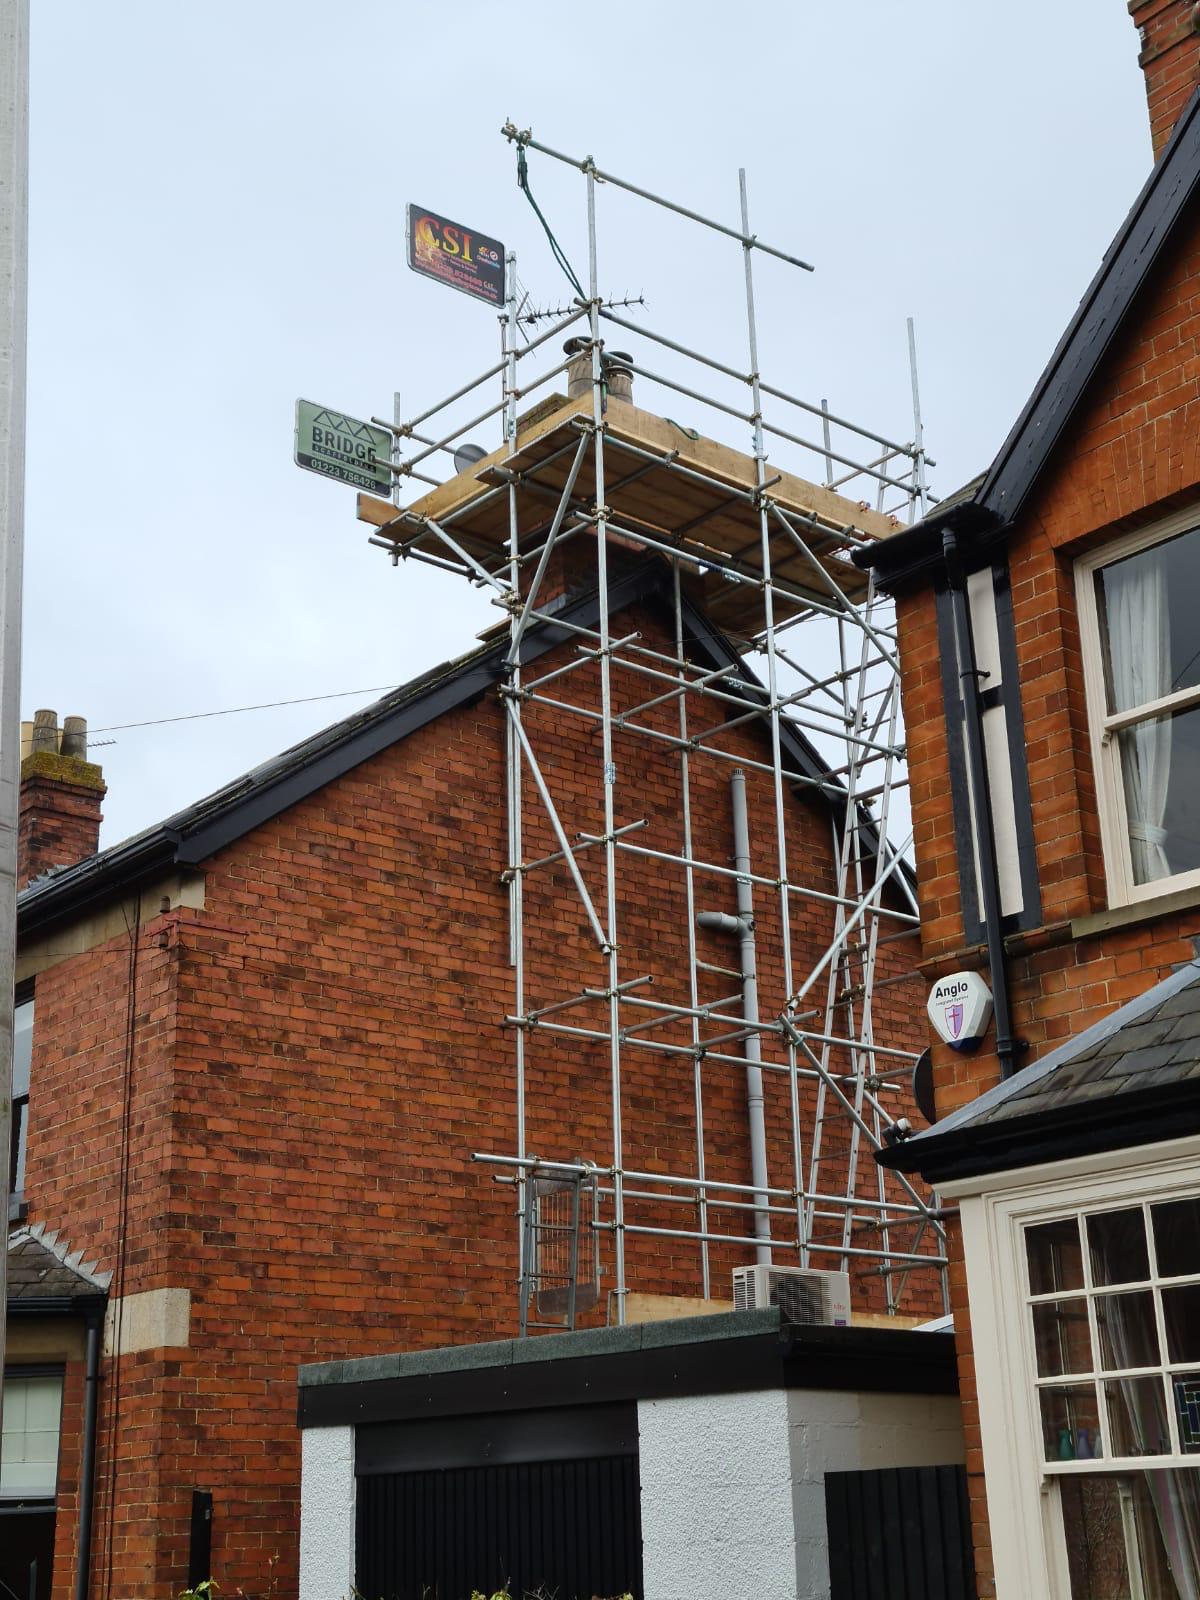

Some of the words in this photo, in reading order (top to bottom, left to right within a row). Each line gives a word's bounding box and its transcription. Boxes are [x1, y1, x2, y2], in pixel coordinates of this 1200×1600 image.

[418, 216, 473, 262] CSI
[312, 426, 376, 461] BRIDGE
[311, 459, 340, 476] 01223
[936, 982, 968, 999] Anglo
